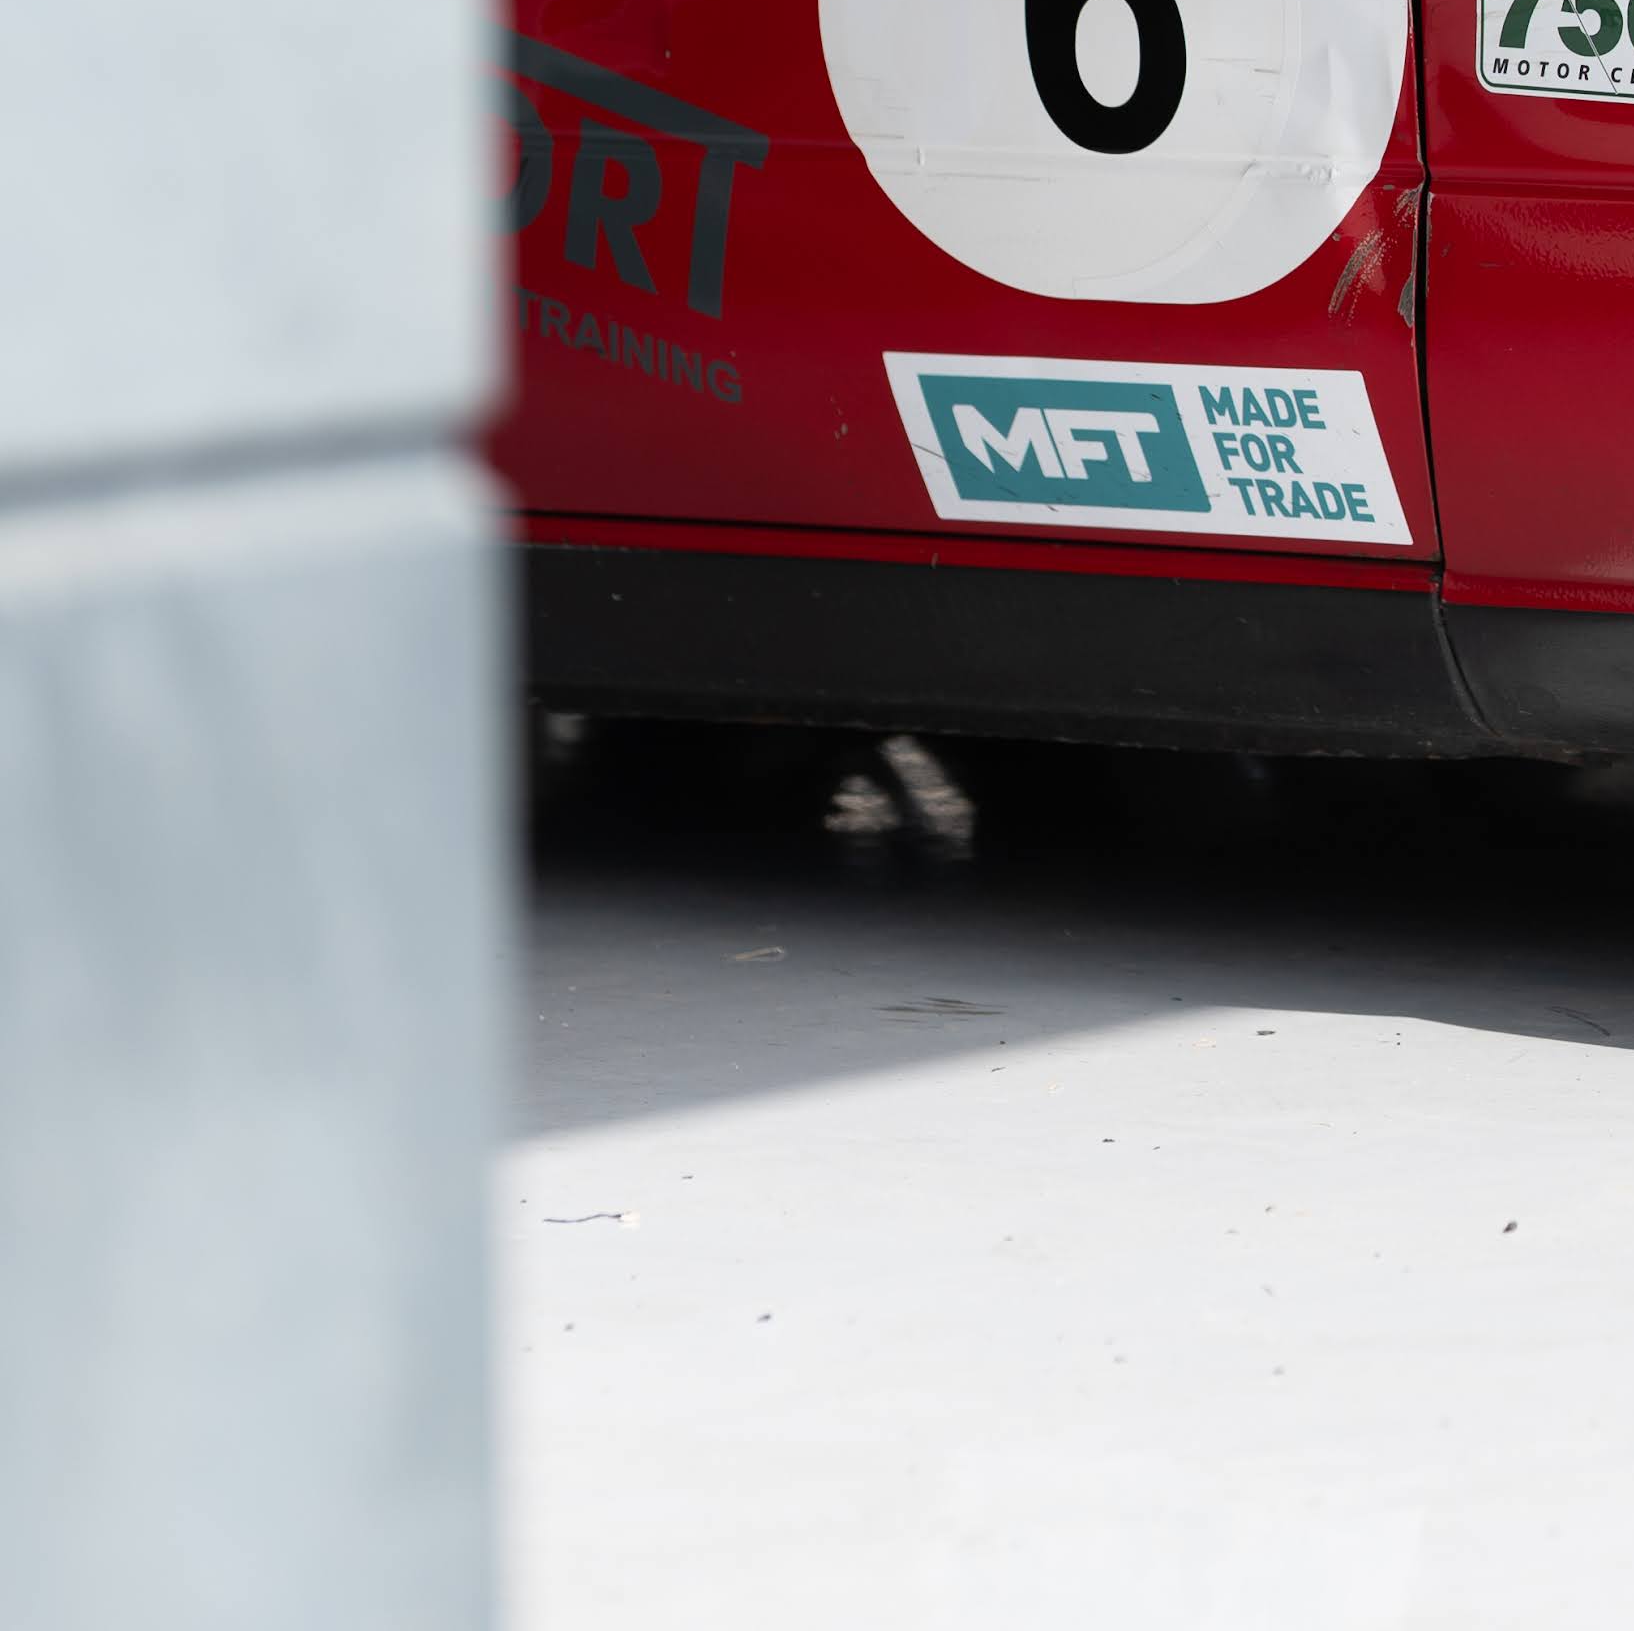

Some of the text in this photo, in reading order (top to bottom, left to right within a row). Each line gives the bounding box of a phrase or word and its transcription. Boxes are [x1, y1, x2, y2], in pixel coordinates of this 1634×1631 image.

[1493, 58, 1590, 81] MOTOR
[511, 283, 743, 404] TRAINING
[1198, 385, 1326, 429] MADE
[952, 403, 1160, 483] MFT
[1213, 432, 1303, 474] FOR
[1229, 478, 1375, 523] TRADE
